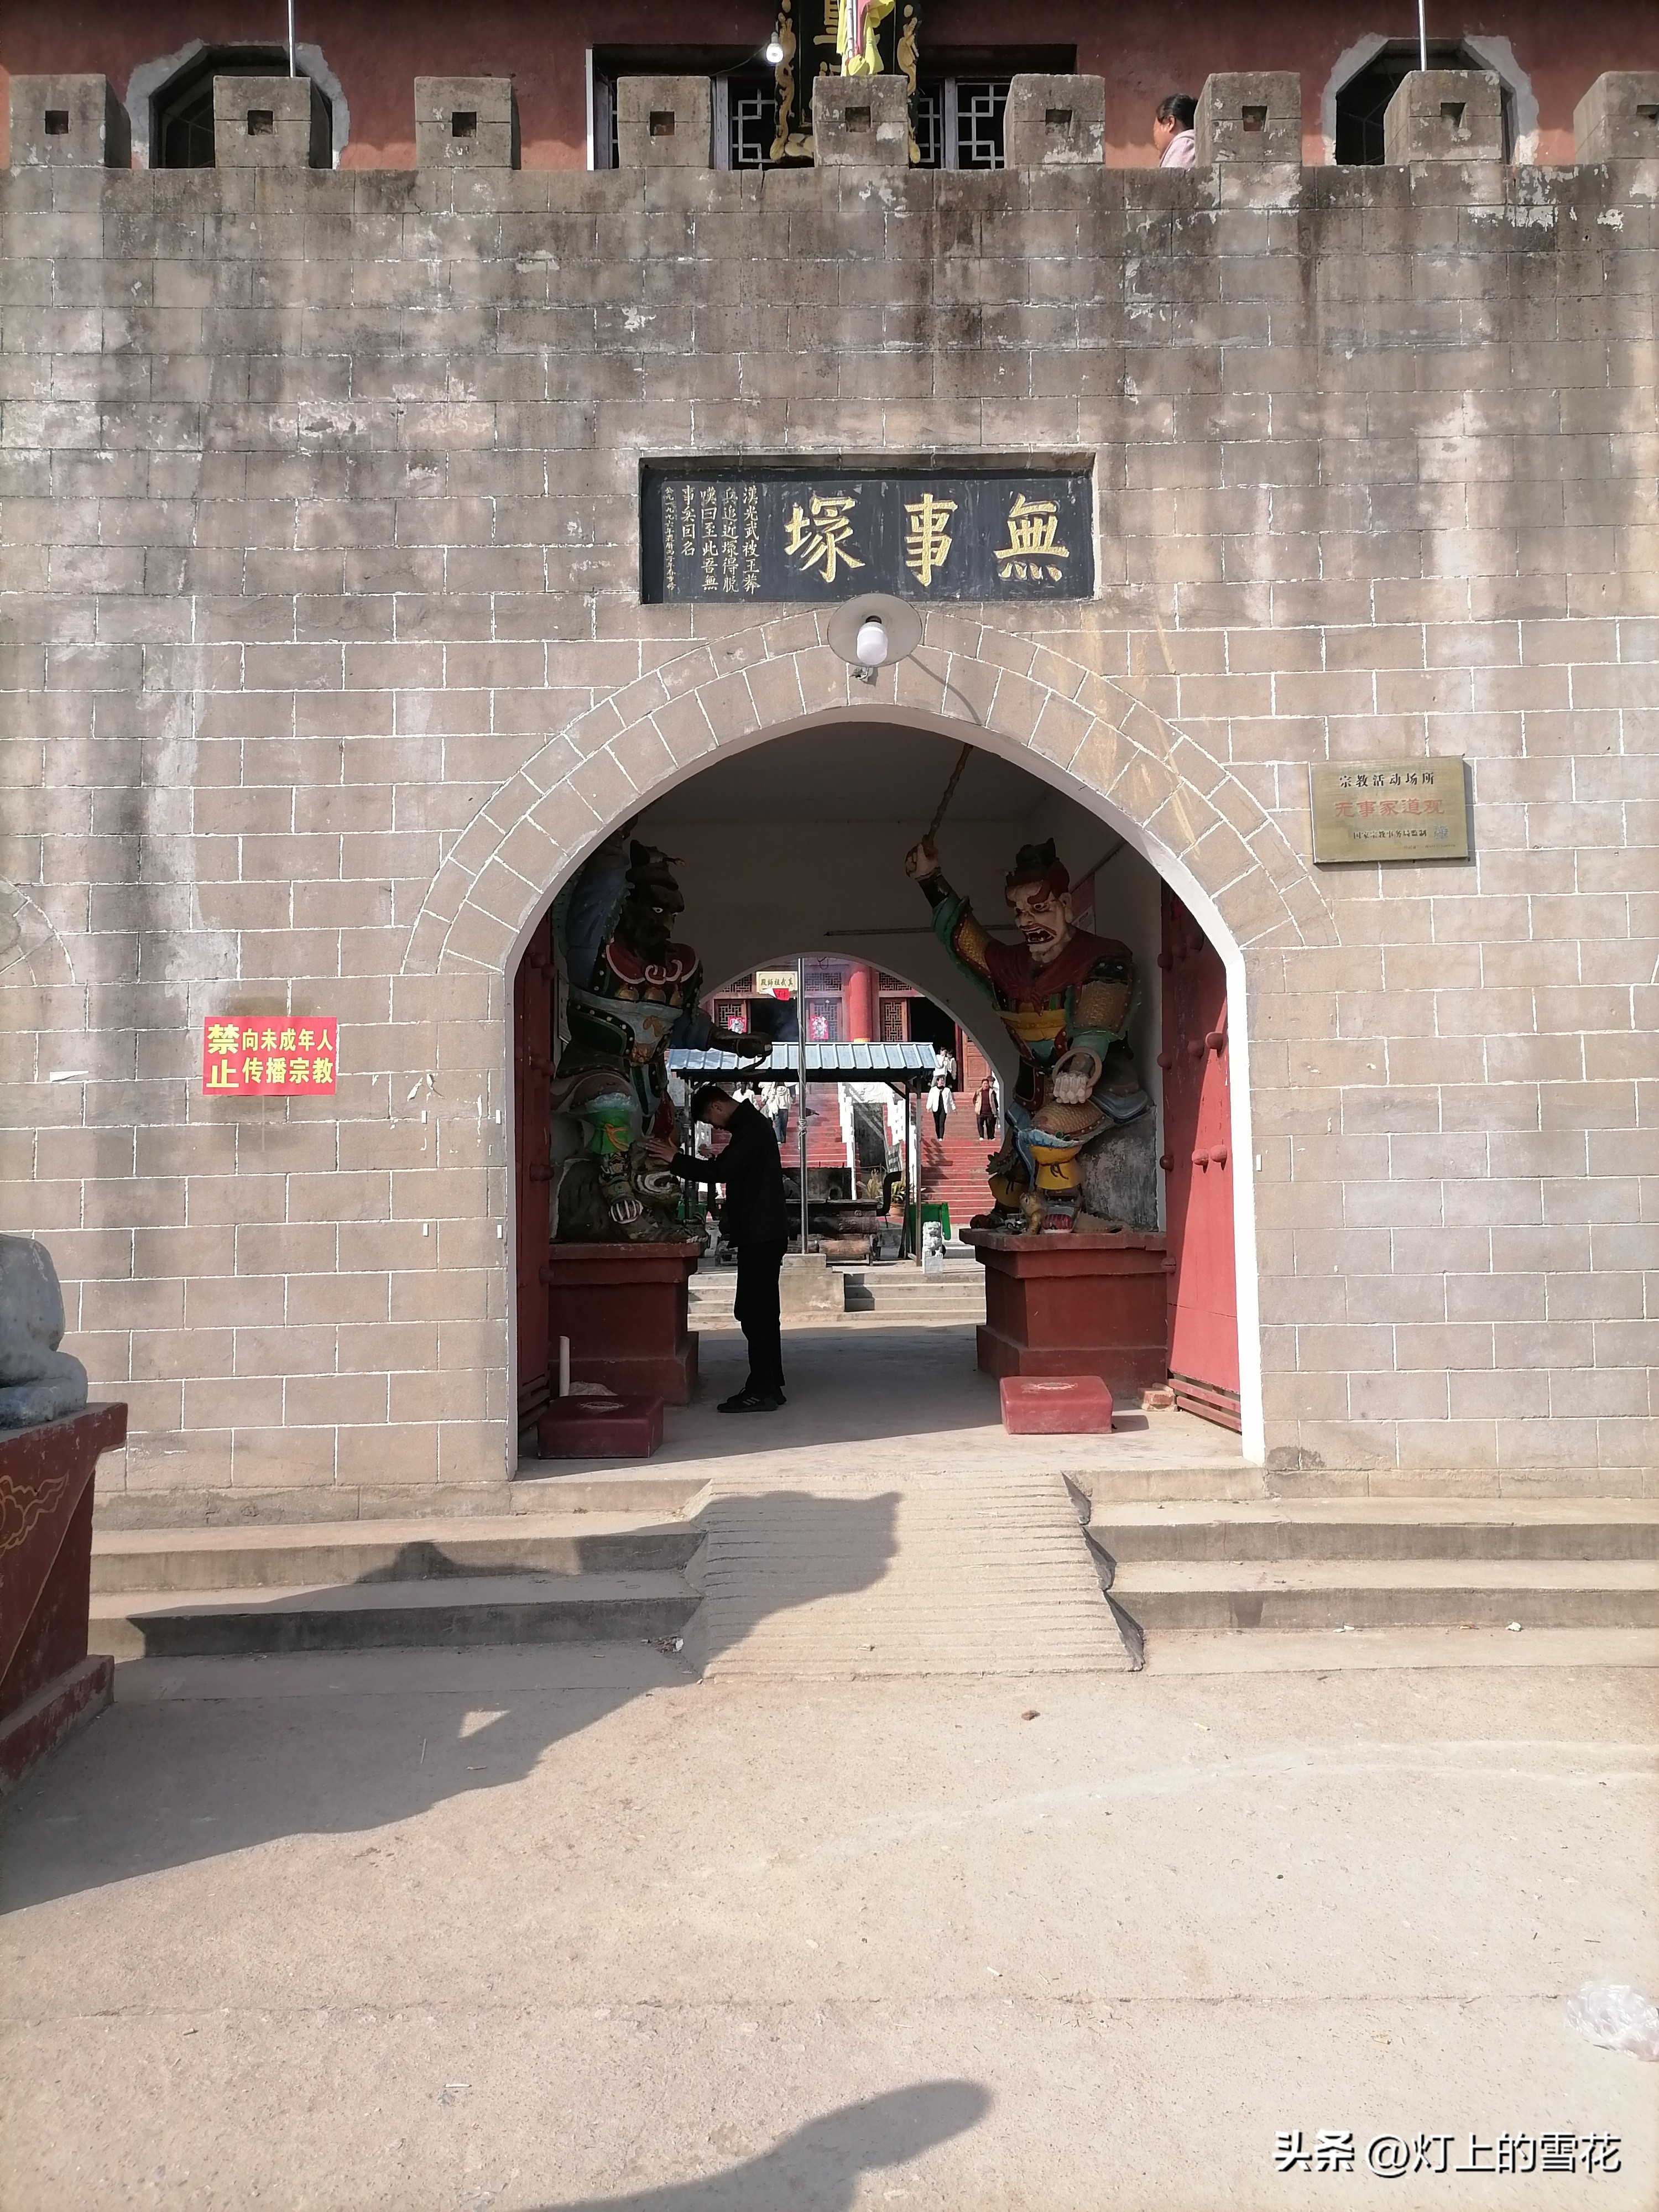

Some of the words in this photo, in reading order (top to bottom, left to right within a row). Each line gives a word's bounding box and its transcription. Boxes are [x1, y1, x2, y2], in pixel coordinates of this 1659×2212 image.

[1339, 772, 1434, 787] 宗教活动场所
[242, 1027, 333, 1051] 向未成年人
[242, 1057, 333, 1084] 传播宗教
